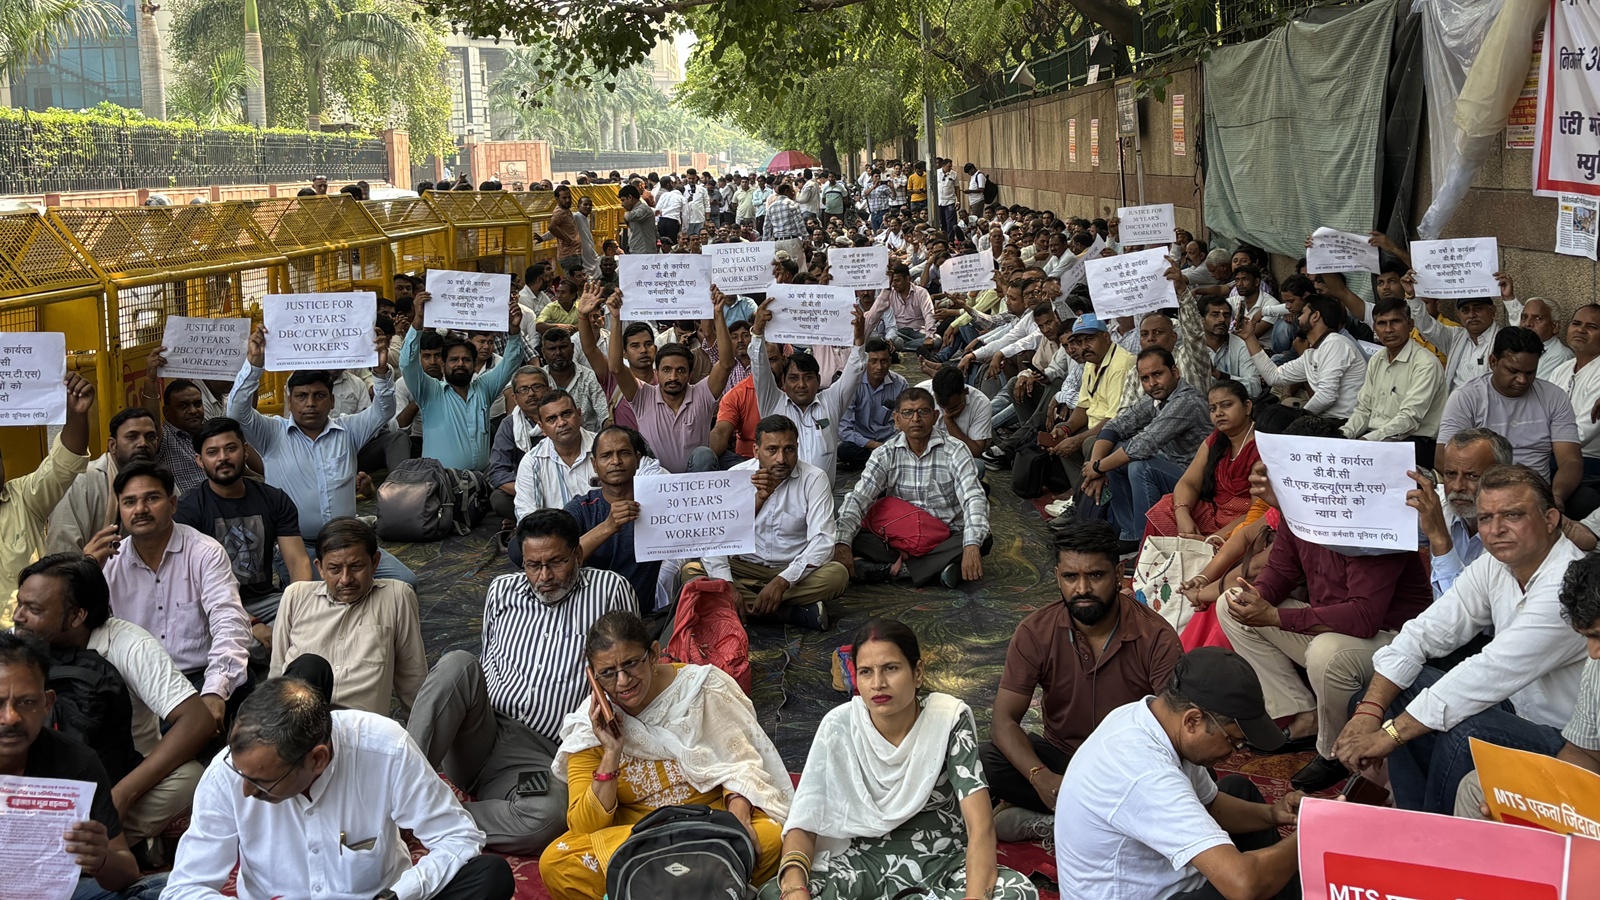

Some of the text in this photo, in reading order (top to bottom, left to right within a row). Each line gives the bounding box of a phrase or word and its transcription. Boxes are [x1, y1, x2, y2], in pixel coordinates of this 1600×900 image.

[1559, 111, 1585, 135] एंटी
[285, 300, 353, 310] JUSTICE FOR
[294, 314, 347, 324] 30 YEAR'S
[279, 328, 362, 339] DBC/CFW (MTS)
[3, 345, 33, 354] कार्यरत
[293, 342, 349, 352] WORKER'S
[216, 349, 240, 357] (MTS)
[182, 358, 228, 366] WORKER'S
[10, 381, 22, 390] को
[1328, 453, 1335, 464] से
[1341, 455, 1373, 466] कार्यरत
[1314, 467, 1350, 479] डी.बी.सी
[658, 479, 730, 493] JUSTICE FOR
[667, 495, 723, 508] 30 YEAR'S
[1302, 494, 1365, 505] कर्मचारियों को
[651, 510, 739, 525] DBC/CFW (MTS)
[1316, 508, 1353, 519] न्याय दो
[665, 526, 725, 539] WORKER'S
[1493, 787, 1527, 811] MTS
[1525, 798, 1561, 823] एकता
[1329, 883, 1379, 900] MTS
